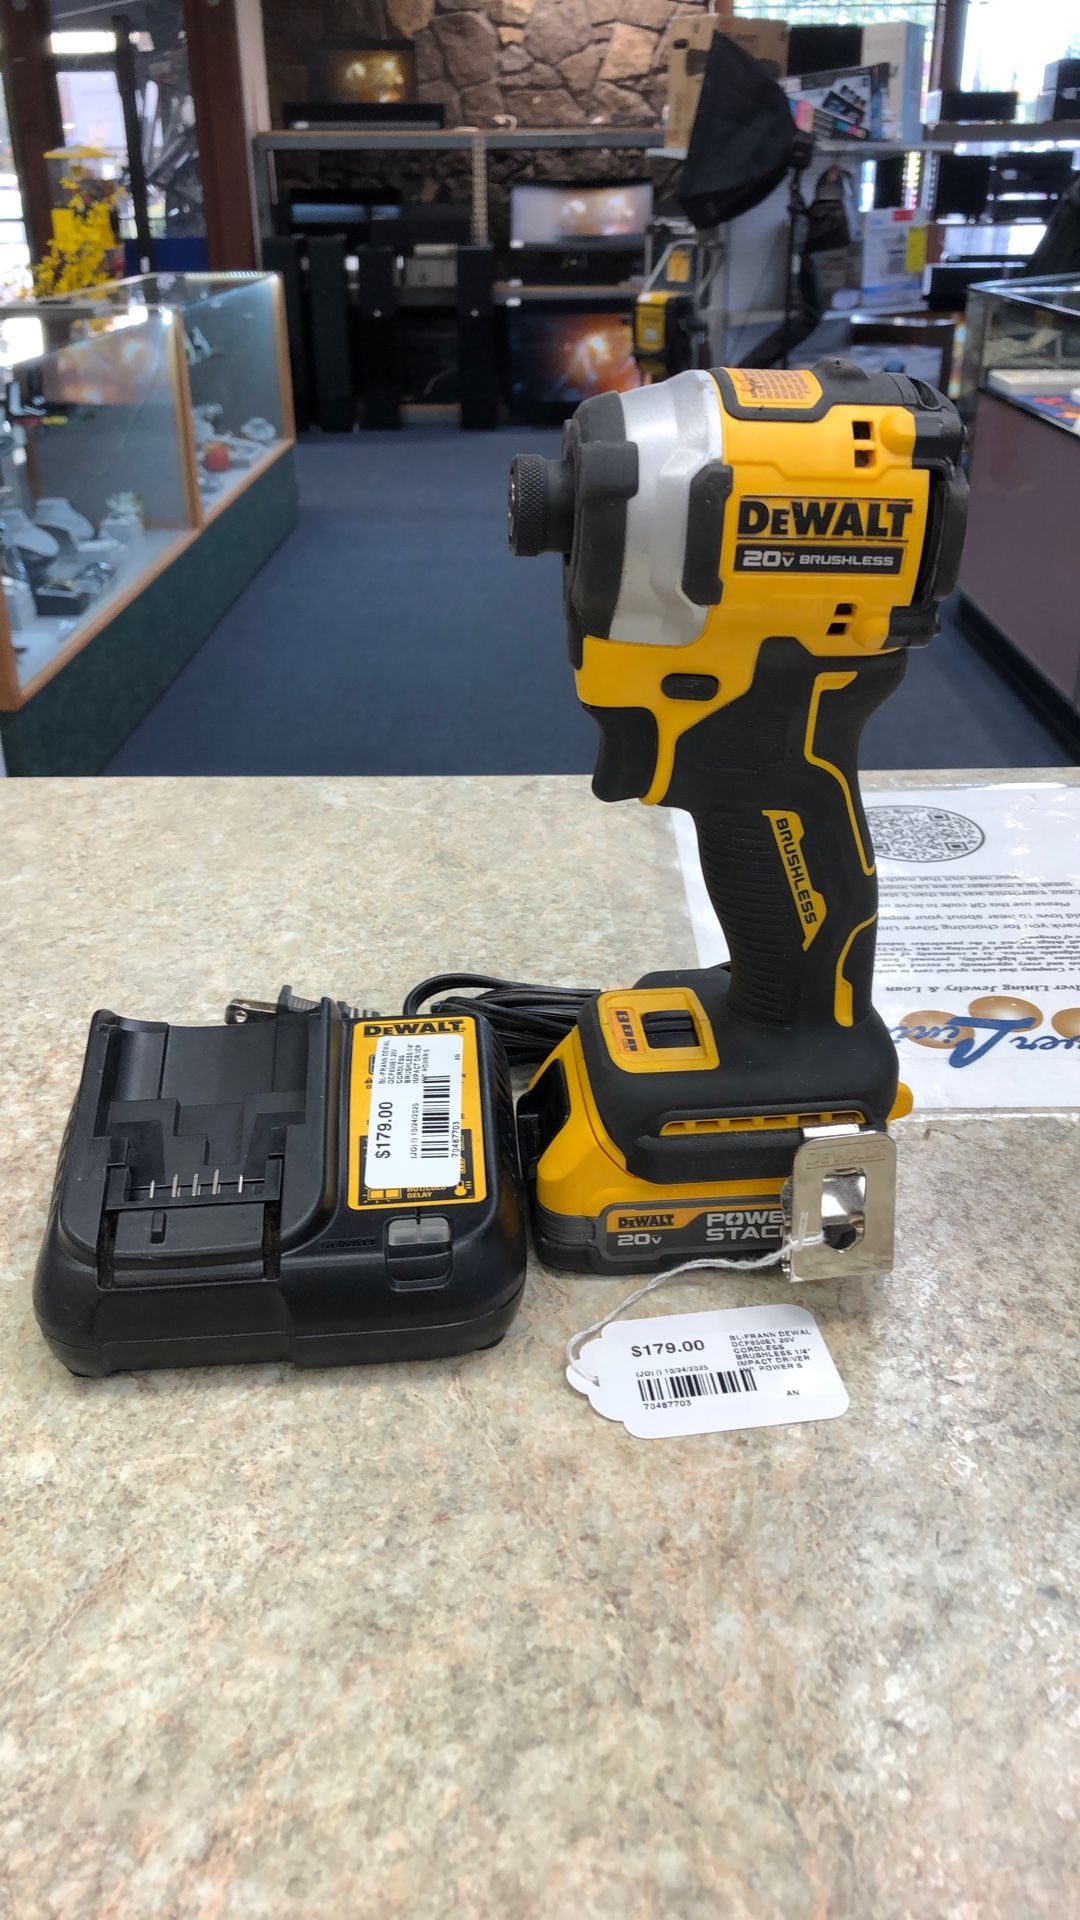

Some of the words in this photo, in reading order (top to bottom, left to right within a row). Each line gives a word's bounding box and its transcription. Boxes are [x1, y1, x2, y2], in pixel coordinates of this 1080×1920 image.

[800, 555, 894, 566] BRUSHLESS
[775, 817, 818, 925] BRUSHLESS
[944, 984, 998, 992] Jewelry
[1002, 984, 1049, 992] Lining
[411, 1103, 420, 1136] 10/24/2025
[375, 1102, 393, 1158] $179.00
[452, 1121, 460, 1158] 70487703
[729, 1332, 776, 1340] BL-FRANN
[631, 1340, 705, 1358] $179.00
[734, 1344, 784, 1354] CORDLESS
[736, 1350, 792, 1360] BRUSHLESS
[737, 1358, 772, 1366] IMPACT
[776, 1355, 810, 1364] DRIVER
[664, 1364, 708, 1374] 10/24/2025
[759, 1363, 794, 1371] POWER
[643, 1399, 692, 1410] 70487703
